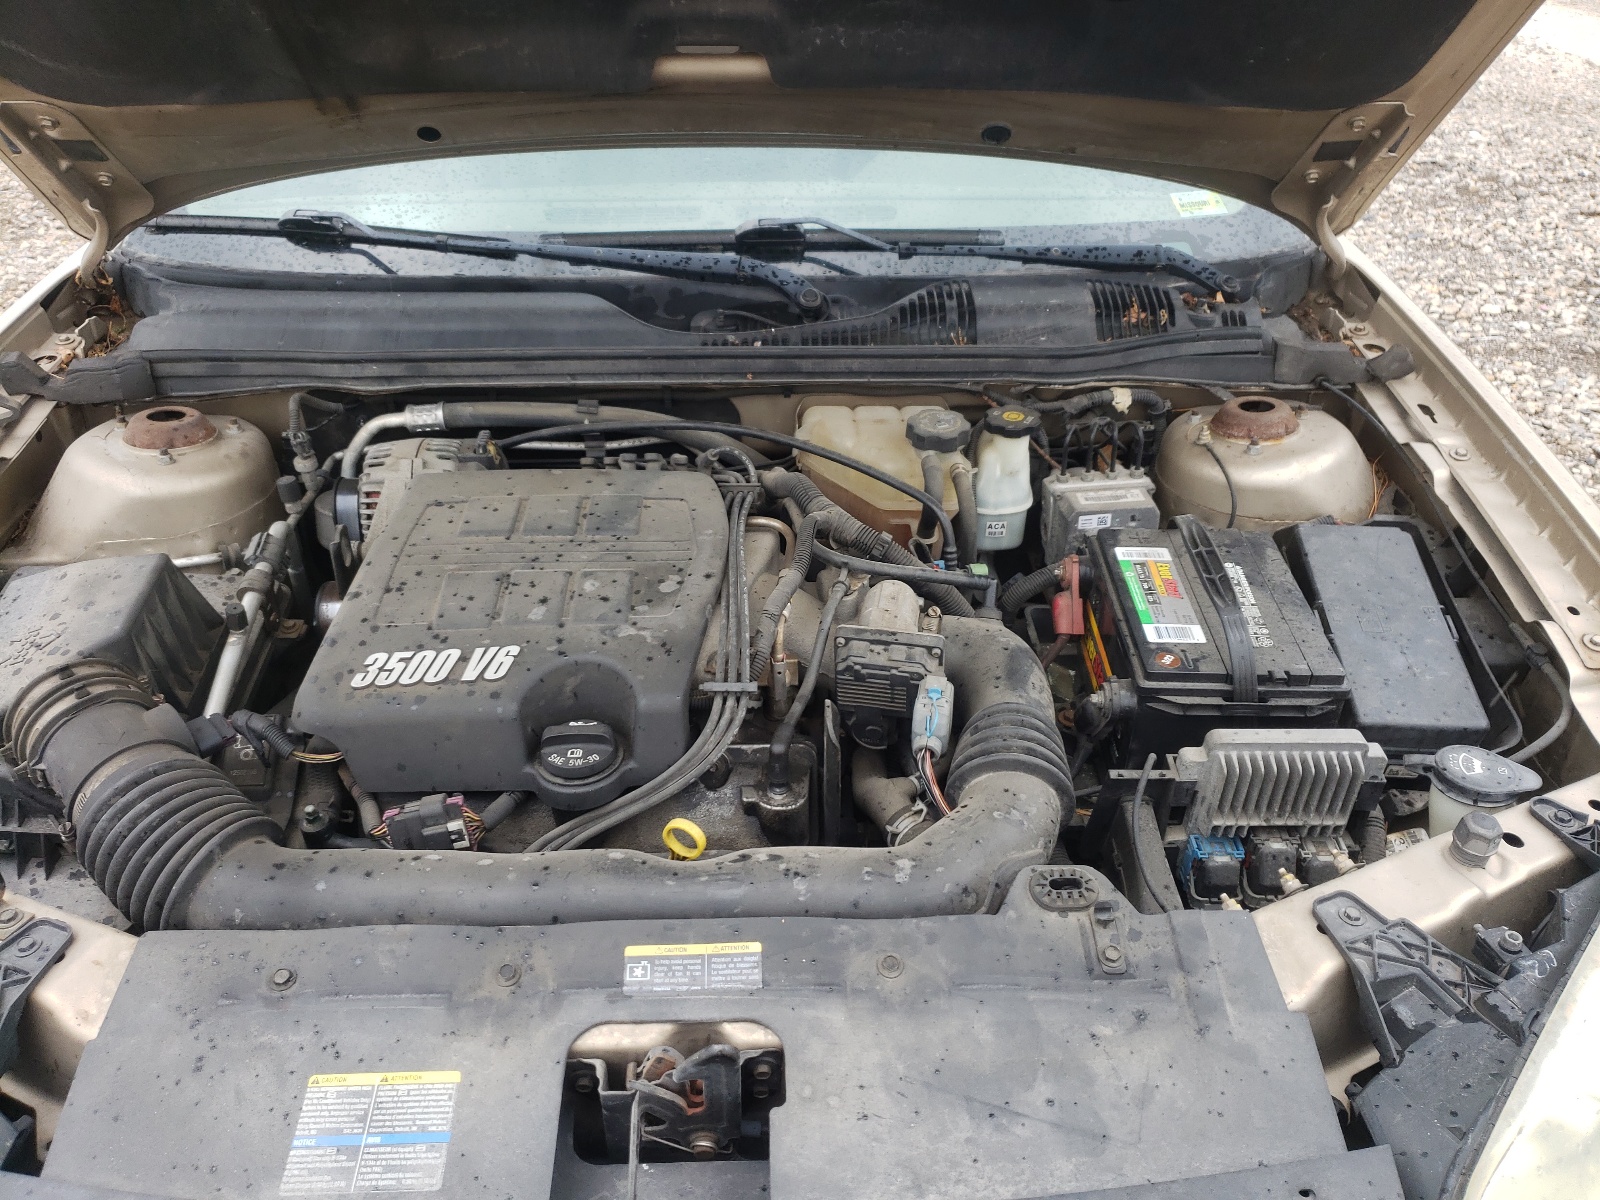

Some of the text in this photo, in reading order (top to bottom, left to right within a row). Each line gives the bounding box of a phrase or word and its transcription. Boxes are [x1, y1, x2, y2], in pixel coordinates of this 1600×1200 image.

[350, 645, 521, 688] 3500 V6
[548, 754, 600, 766] SAE 5W-30
